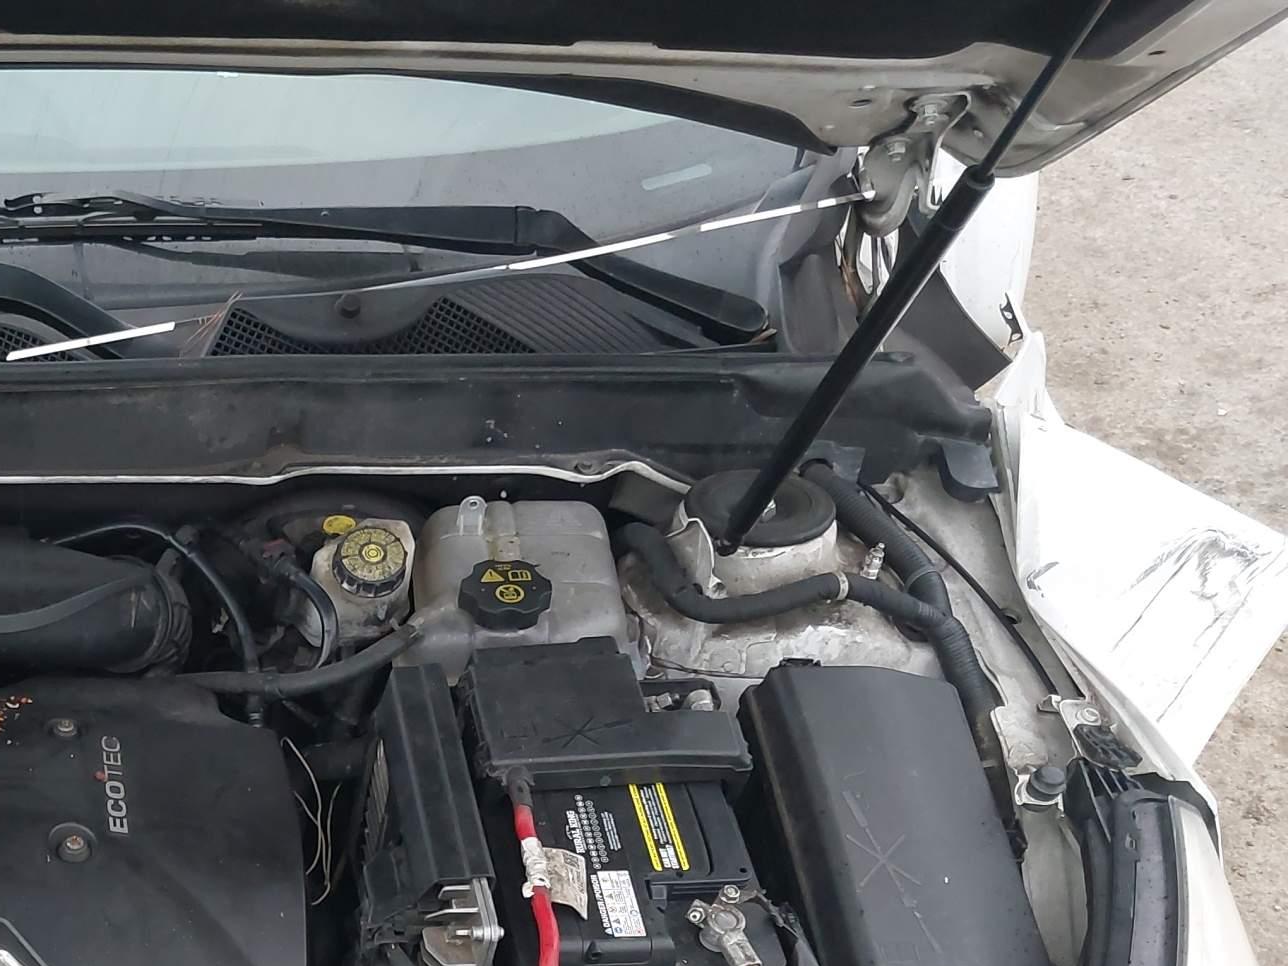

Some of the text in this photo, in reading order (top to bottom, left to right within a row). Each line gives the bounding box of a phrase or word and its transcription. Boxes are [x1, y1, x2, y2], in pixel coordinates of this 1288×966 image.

[101, 735, 129, 834] ECOTEC
[566, 810, 579, 829] KING
[571, 829, 585, 853] RURAL
